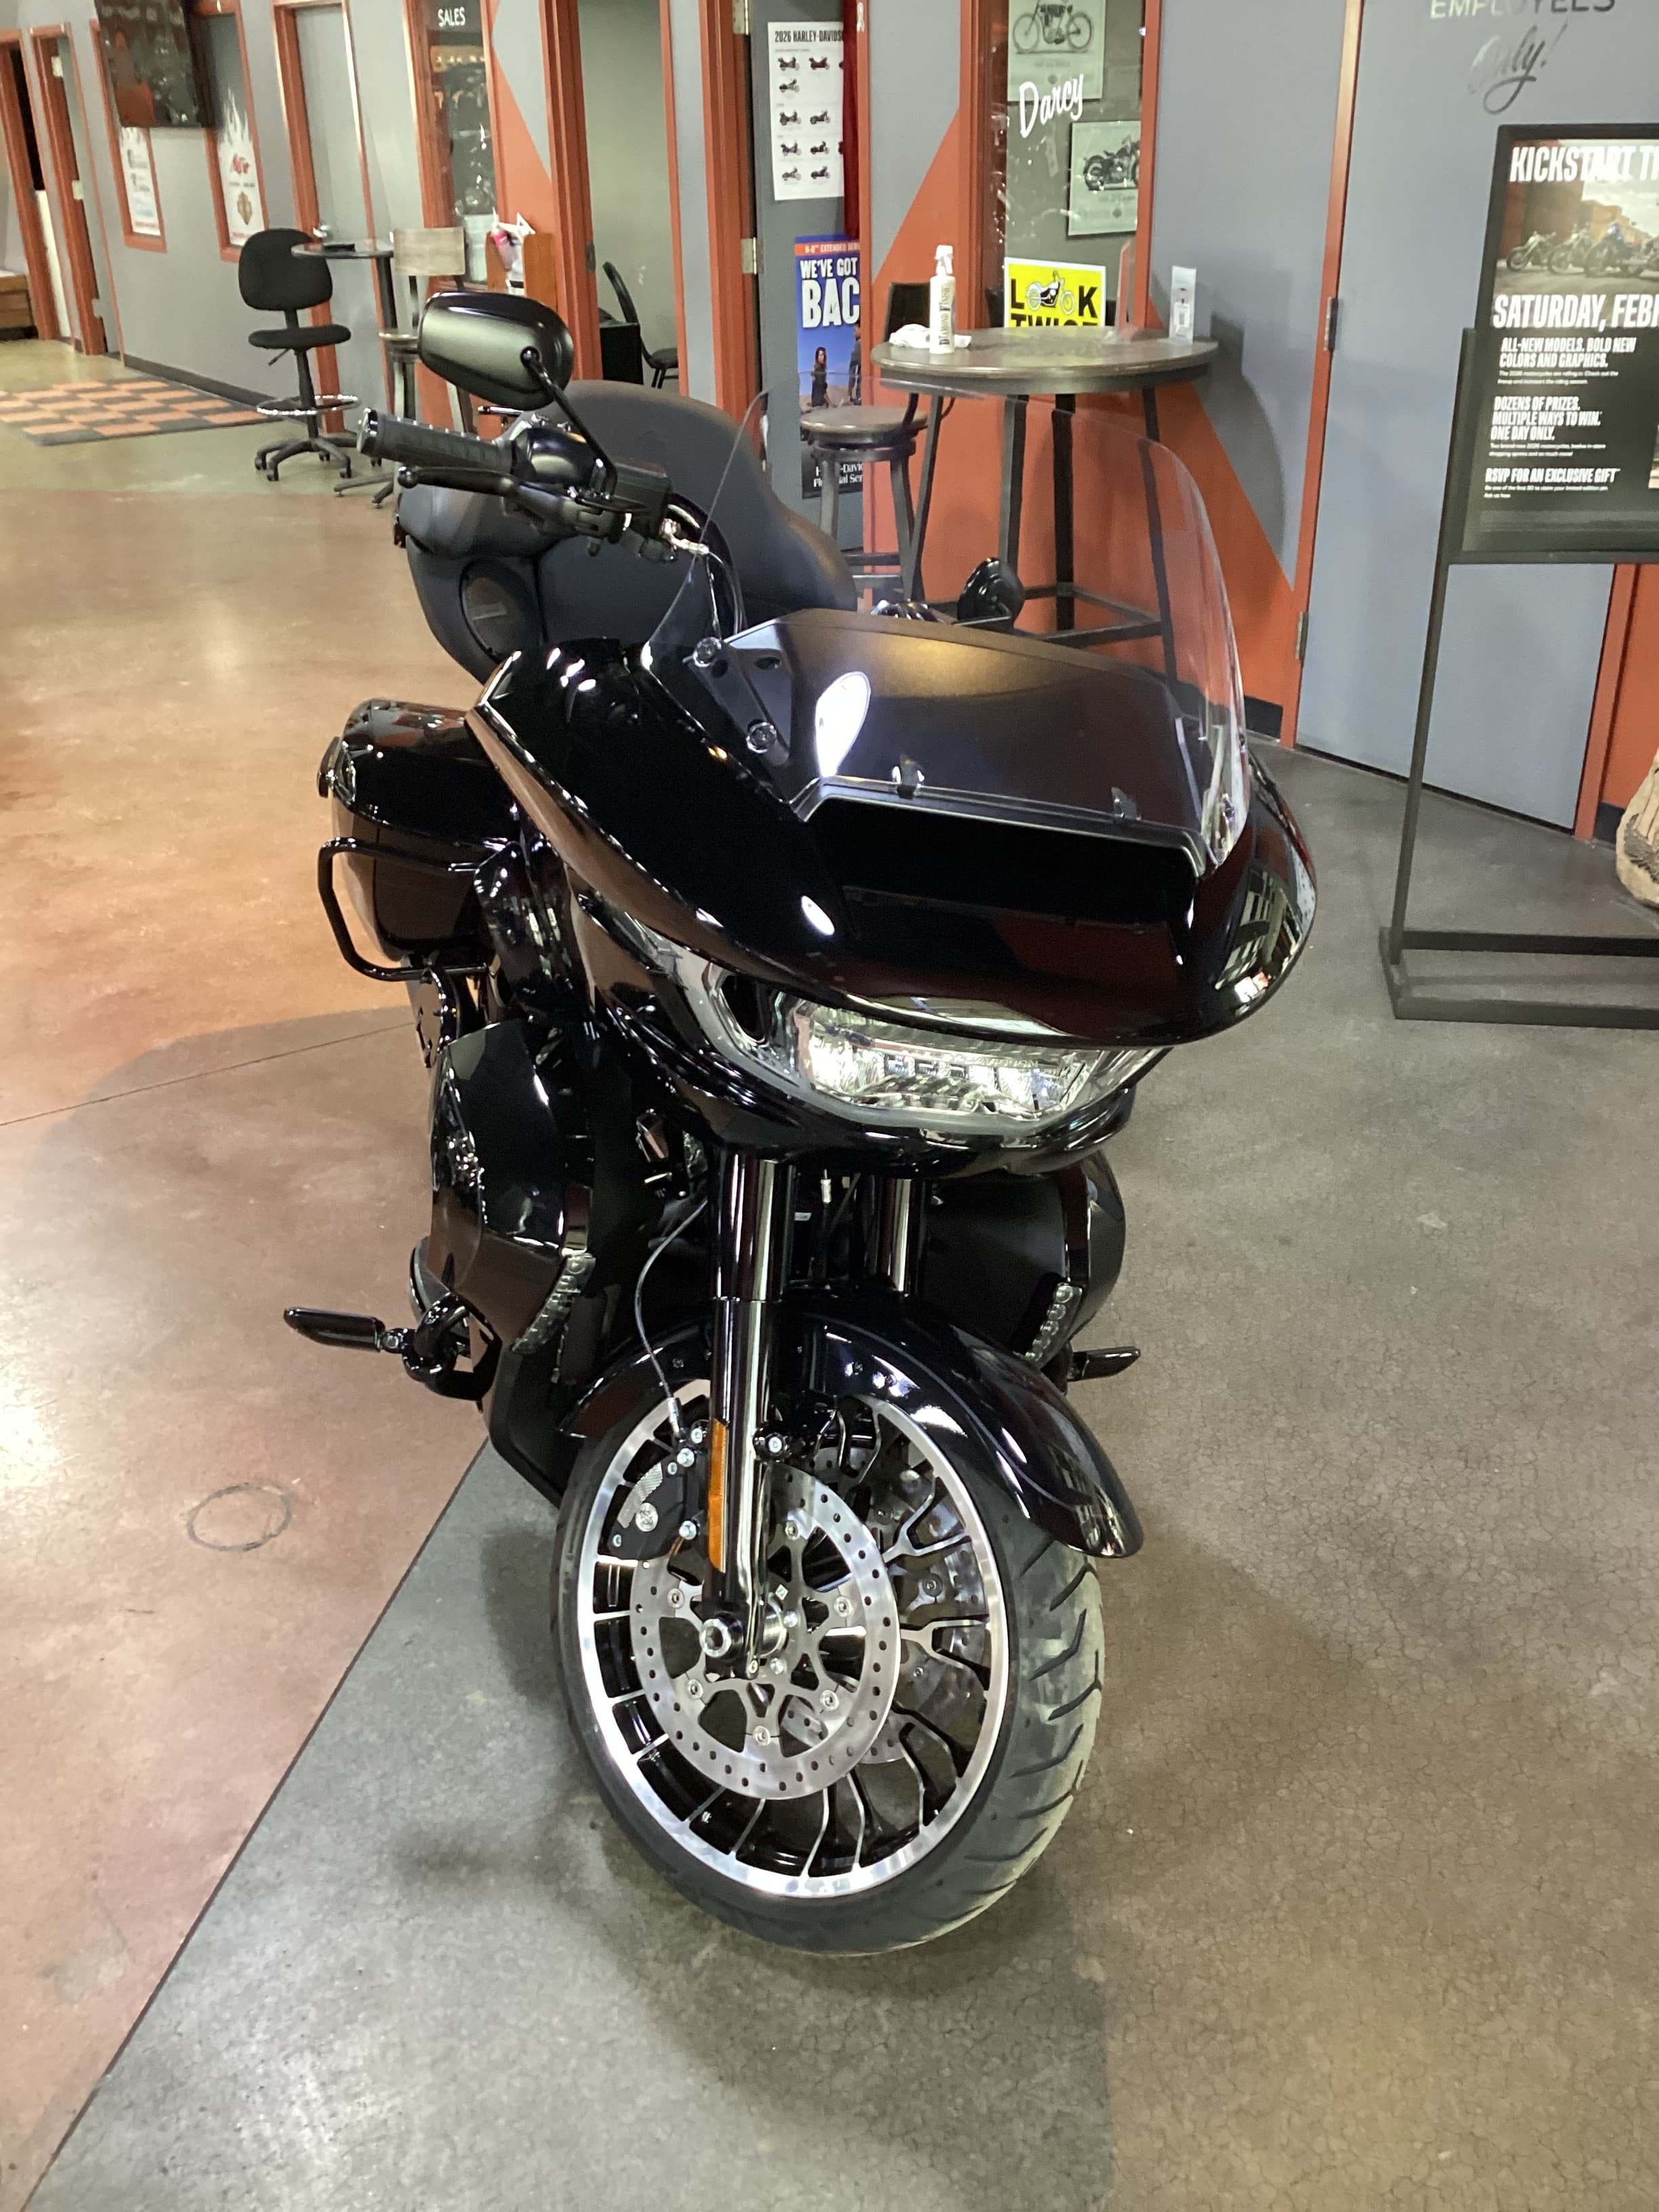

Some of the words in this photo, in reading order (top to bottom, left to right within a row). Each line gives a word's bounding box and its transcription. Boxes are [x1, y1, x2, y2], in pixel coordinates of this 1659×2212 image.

[438, 7, 466, 26] SALES
[775, 30, 792, 42] 2026
[793, 29, 844, 42] HARLEY-DAVIDS
[1019, 73, 1084, 138] Darcy
[1509, 145, 1636, 182] KICKSTART
[800, 259, 833, 279] WE'VE
[836, 257, 858, 276] GOT
[1492, 294, 1606, 332] SATURDAY,
[1500, 337, 1544, 352] ALL-NEW
[1544, 337, 1585, 352] MODELS.
[1586, 337, 1612, 352] BOLD
[1612, 337, 1637, 352] NEW
[1499, 352, 1536, 367] COLORS
[1536, 352, 1558, 367] AND
[1558, 352, 1608, 367] GRAPHICS.
[1494, 396, 1531, 411] DOZENS
[1532, 396, 1545, 411] OF
[1545, 396, 1580, 411] PRIZES.
[1492, 411, 1538, 426] MULTIPLE
[1538, 411, 1565, 426] WAYS
[1565, 411, 1578, 426] TO
[1490, 426, 1511, 441] ONE
[1511, 426, 1530, 441] DAY
[1530, 426, 1555, 441] ONLY.
[1485, 468, 1511, 483] RSVP
[1511, 468, 1530, 483] FOR
[1530, 468, 1545, 483] AN
[1544, 468, 1595, 483] EXCLUSIVE
